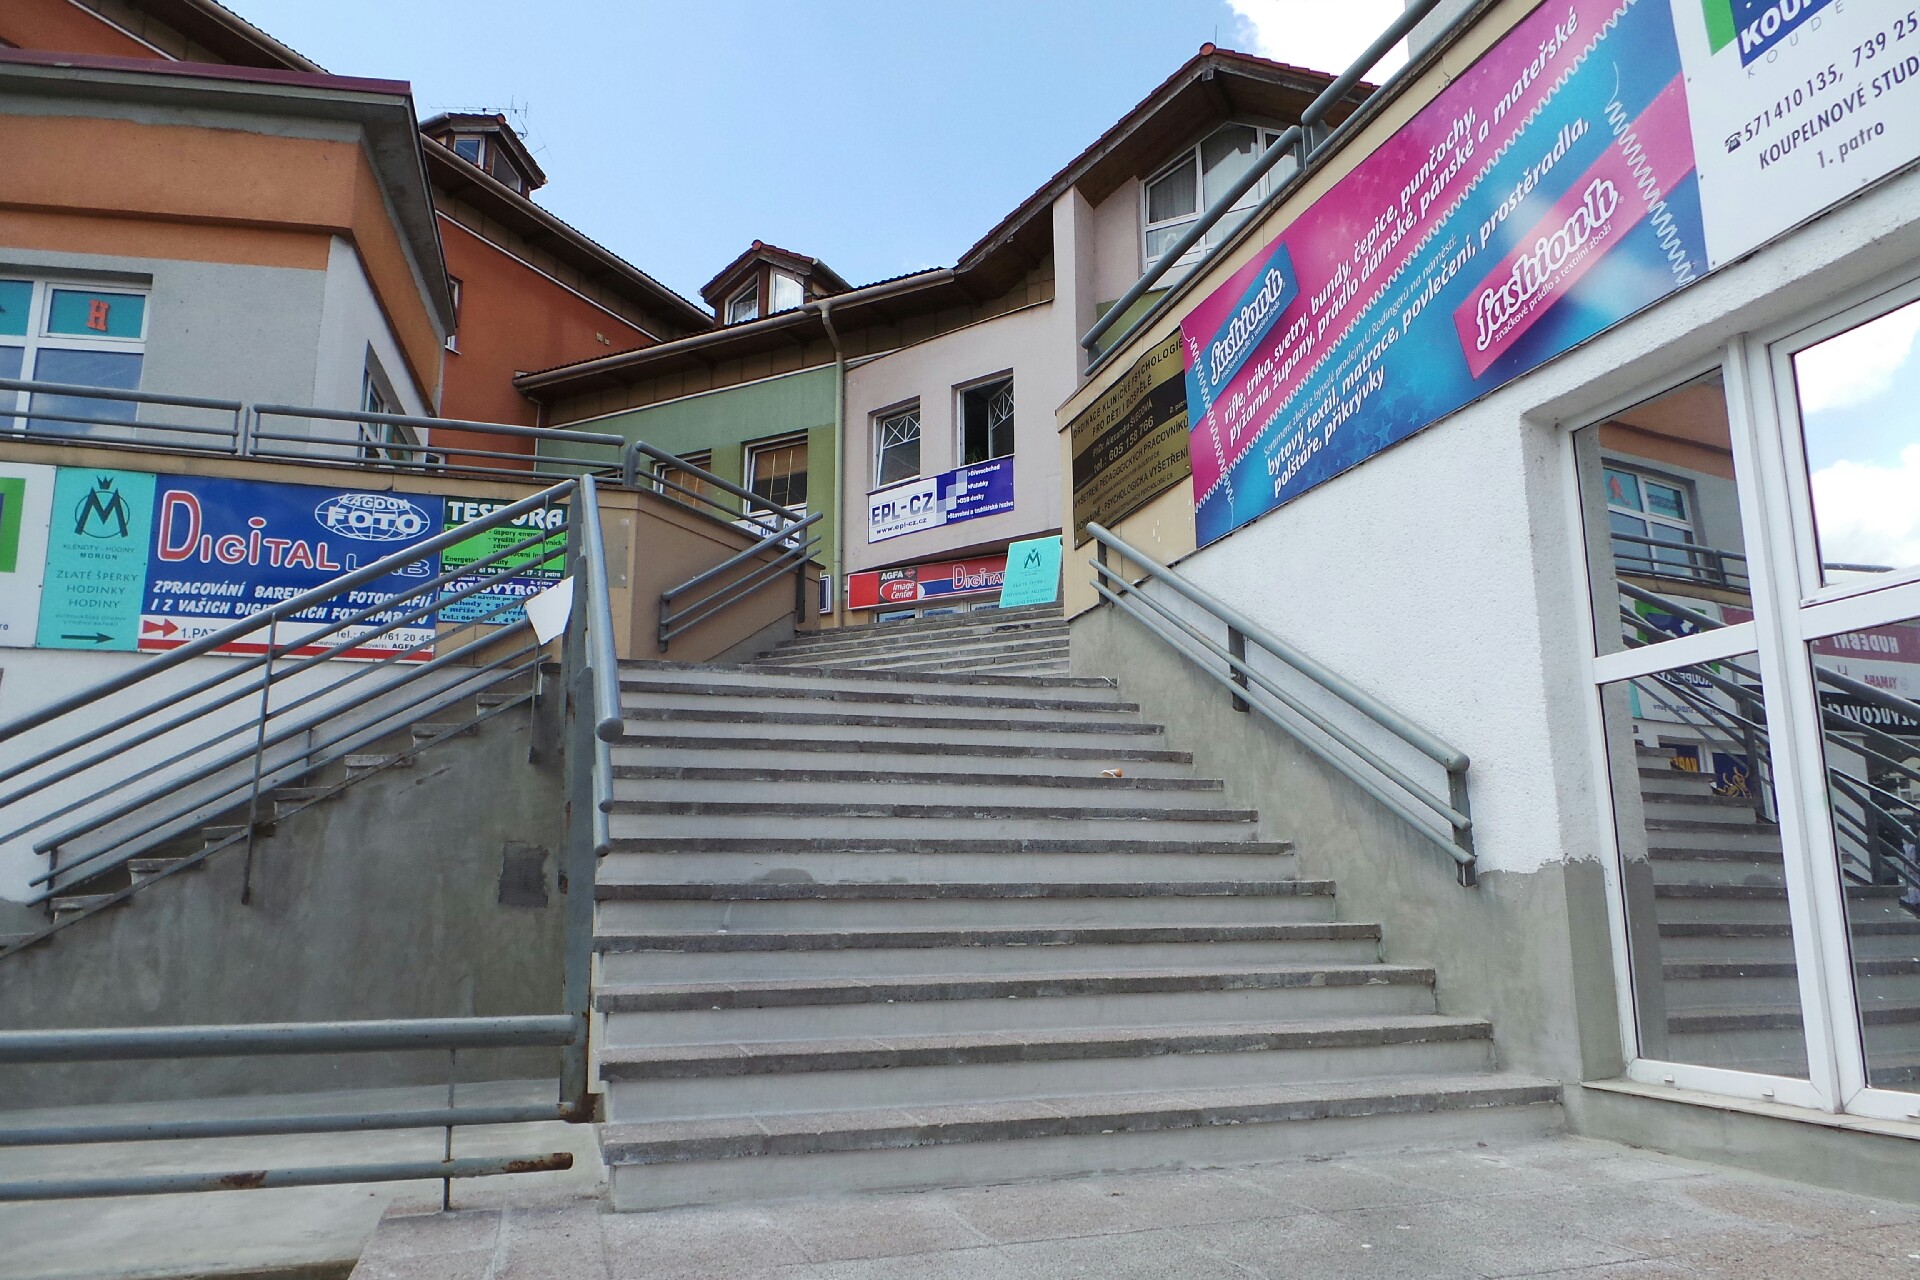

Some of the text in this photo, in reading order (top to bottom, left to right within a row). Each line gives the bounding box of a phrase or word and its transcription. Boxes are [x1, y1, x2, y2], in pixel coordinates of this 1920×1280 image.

[1740, 0, 1812, 54] KOU
[1852, 32, 1886, 68] 739
[1759, 48, 1920, 170] KOUPELNOVÉ STUD
[1817, 121, 1885, 169] 1. patro
[1229, 6, 1579, 447] pyžama, župany, prádlo dámské, pánské a mateřské
[1225, 106, 1478, 425] rifle, trika, svetry, bundy, čepice, punčochy,
[1494, 304, 1529, 343] značkové
[1528, 282, 1554, 312] prádlo
[1560, 246, 1589, 277] textilní
[1588, 221, 1612, 250] zboží
[1267, 117, 1590, 476] bytový textil, matrace, povlečení, prostěradla,
[87, 299, 110, 331] H
[1131, 337, 1183, 389] PSYCHOLOGIE
[1263, 422, 1292, 458] Sortiment
[1335, 341, 1364, 381] prodejny
[1108, 445, 1124, 463] 605
[1125, 432, 1138, 450] 158
[1139, 416, 1154, 437] 766
[1143, 417, 1188, 455] PRACOVNÍKŮ
[1274, 365, 1385, 498] polštáře, přikrývky
[1149, 444, 1189, 480] VYŠETŘENÍ
[327, 506, 421, 534] FOTO
[448, 501, 564, 530] TESRA
[871, 491, 934, 526] EPL-CZ
[876, 517, 927, 535] www.epl-cz.cz
[80, 552, 118, 560] MORION
[345, 553, 430, 578] LB
[56, 568, 139, 582] ZLATÉ ŠPERKY
[66, 585, 126, 595] HODINKY
[152, 580, 247, 597] ZPRACOVÁNÍ
[254, 585, 337, 602] BAREV
[880, 569, 904, 581] AGFA
[892, 581, 915, 592] Image
[69, 599, 121, 609] HODINY
[151, 598, 159, 611] I
[162, 598, 173, 611] Z
[178, 597, 231, 614] VAŠICH
[890, 589, 914, 600] Center
[403, 633, 416, 641] 20
